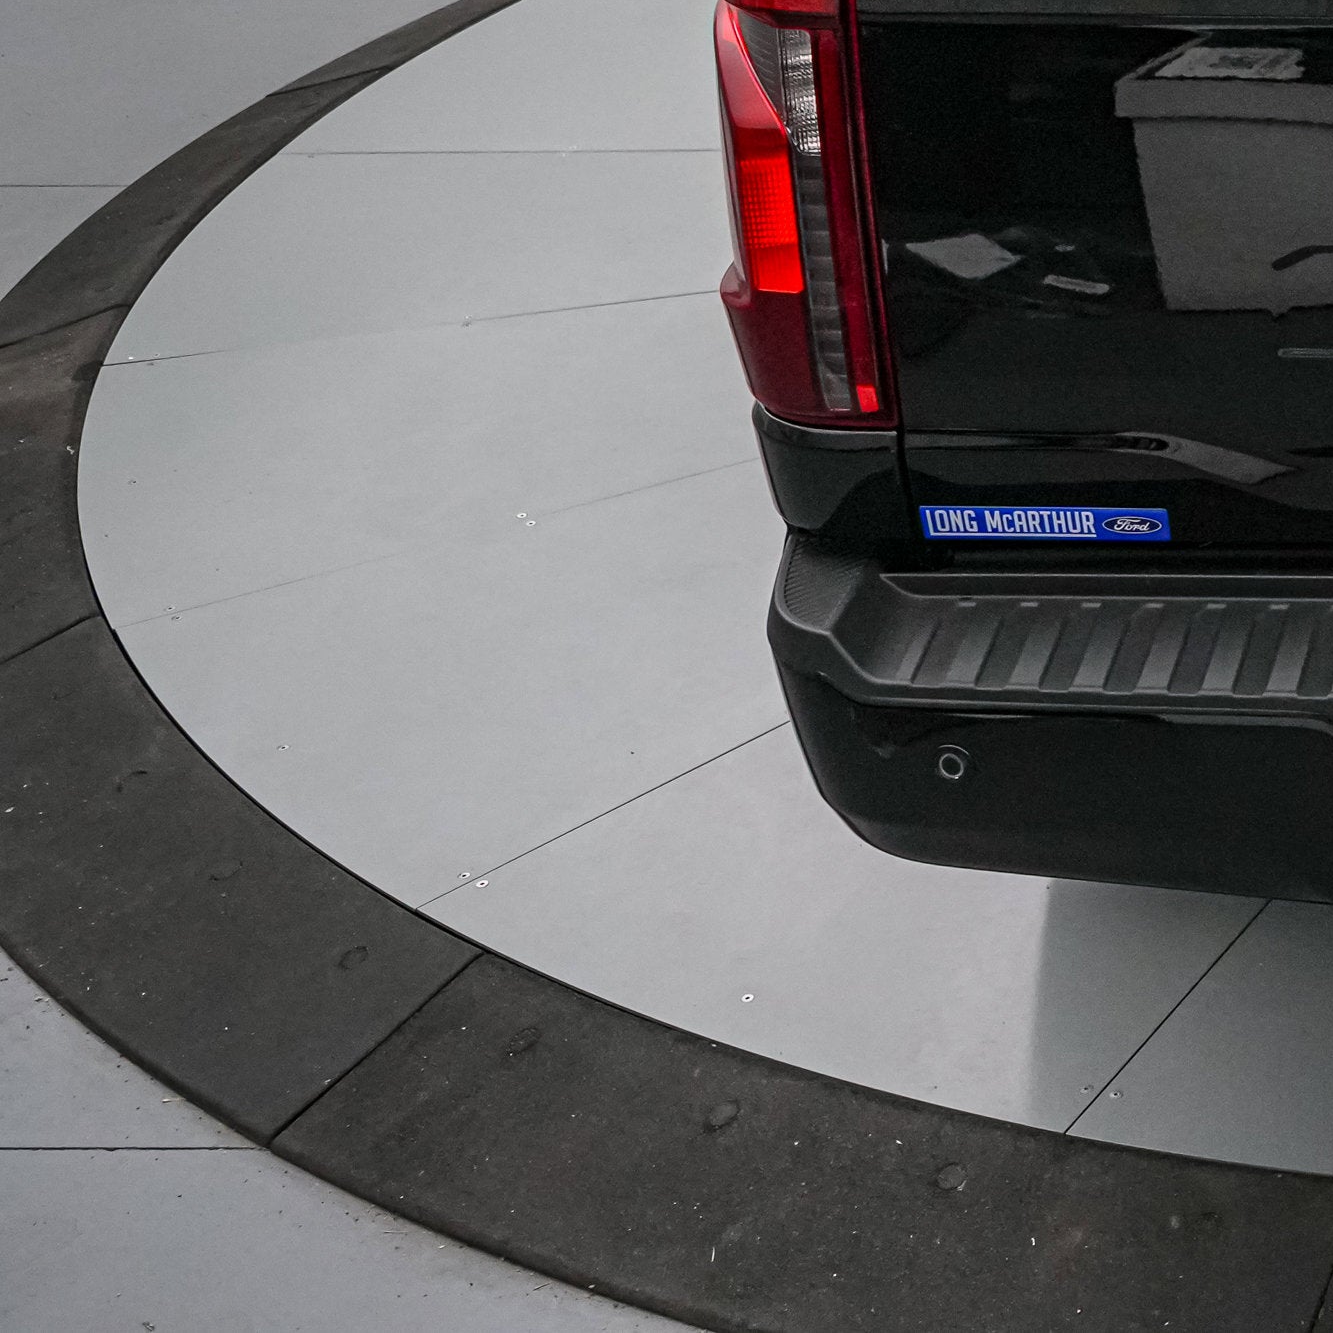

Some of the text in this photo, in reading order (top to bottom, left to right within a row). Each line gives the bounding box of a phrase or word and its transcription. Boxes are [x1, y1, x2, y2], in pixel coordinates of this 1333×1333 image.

[925, 509, 1150, 535] LONG McARTHUR Ford
